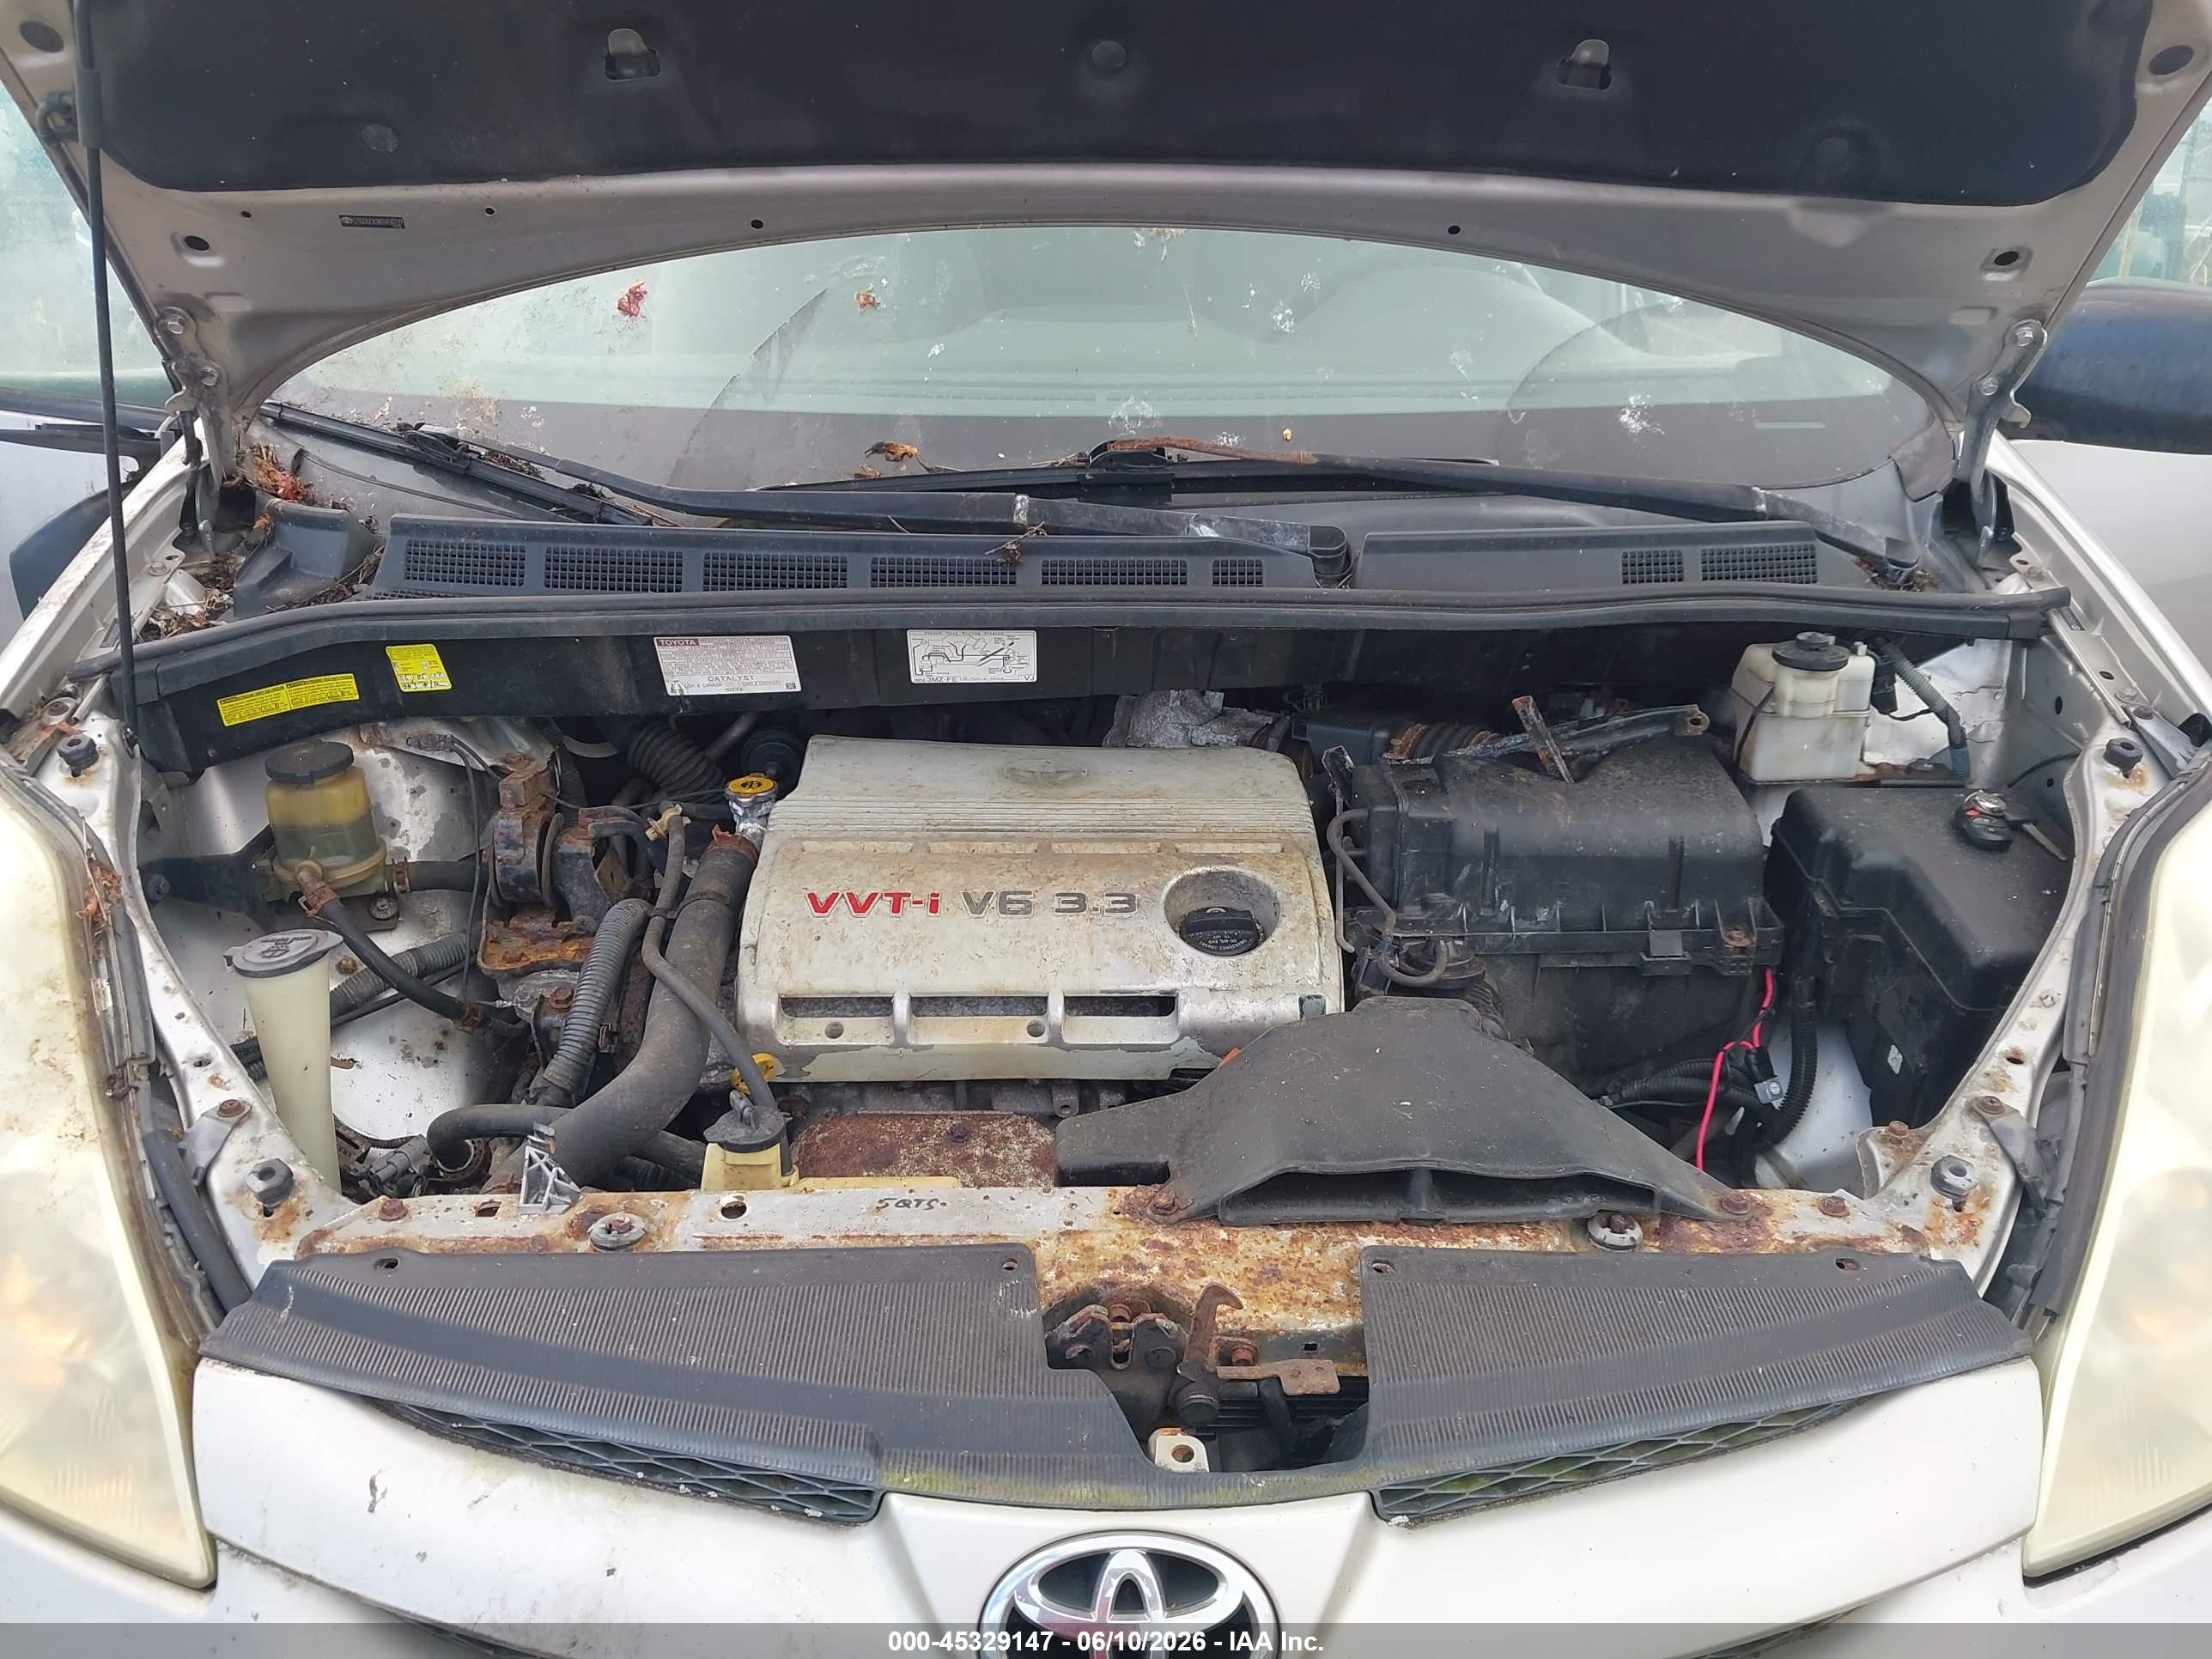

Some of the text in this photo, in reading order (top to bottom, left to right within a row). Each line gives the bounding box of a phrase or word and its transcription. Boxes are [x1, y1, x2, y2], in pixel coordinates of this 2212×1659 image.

[804, 890, 1140, 918] VVT-i V6 3.3
